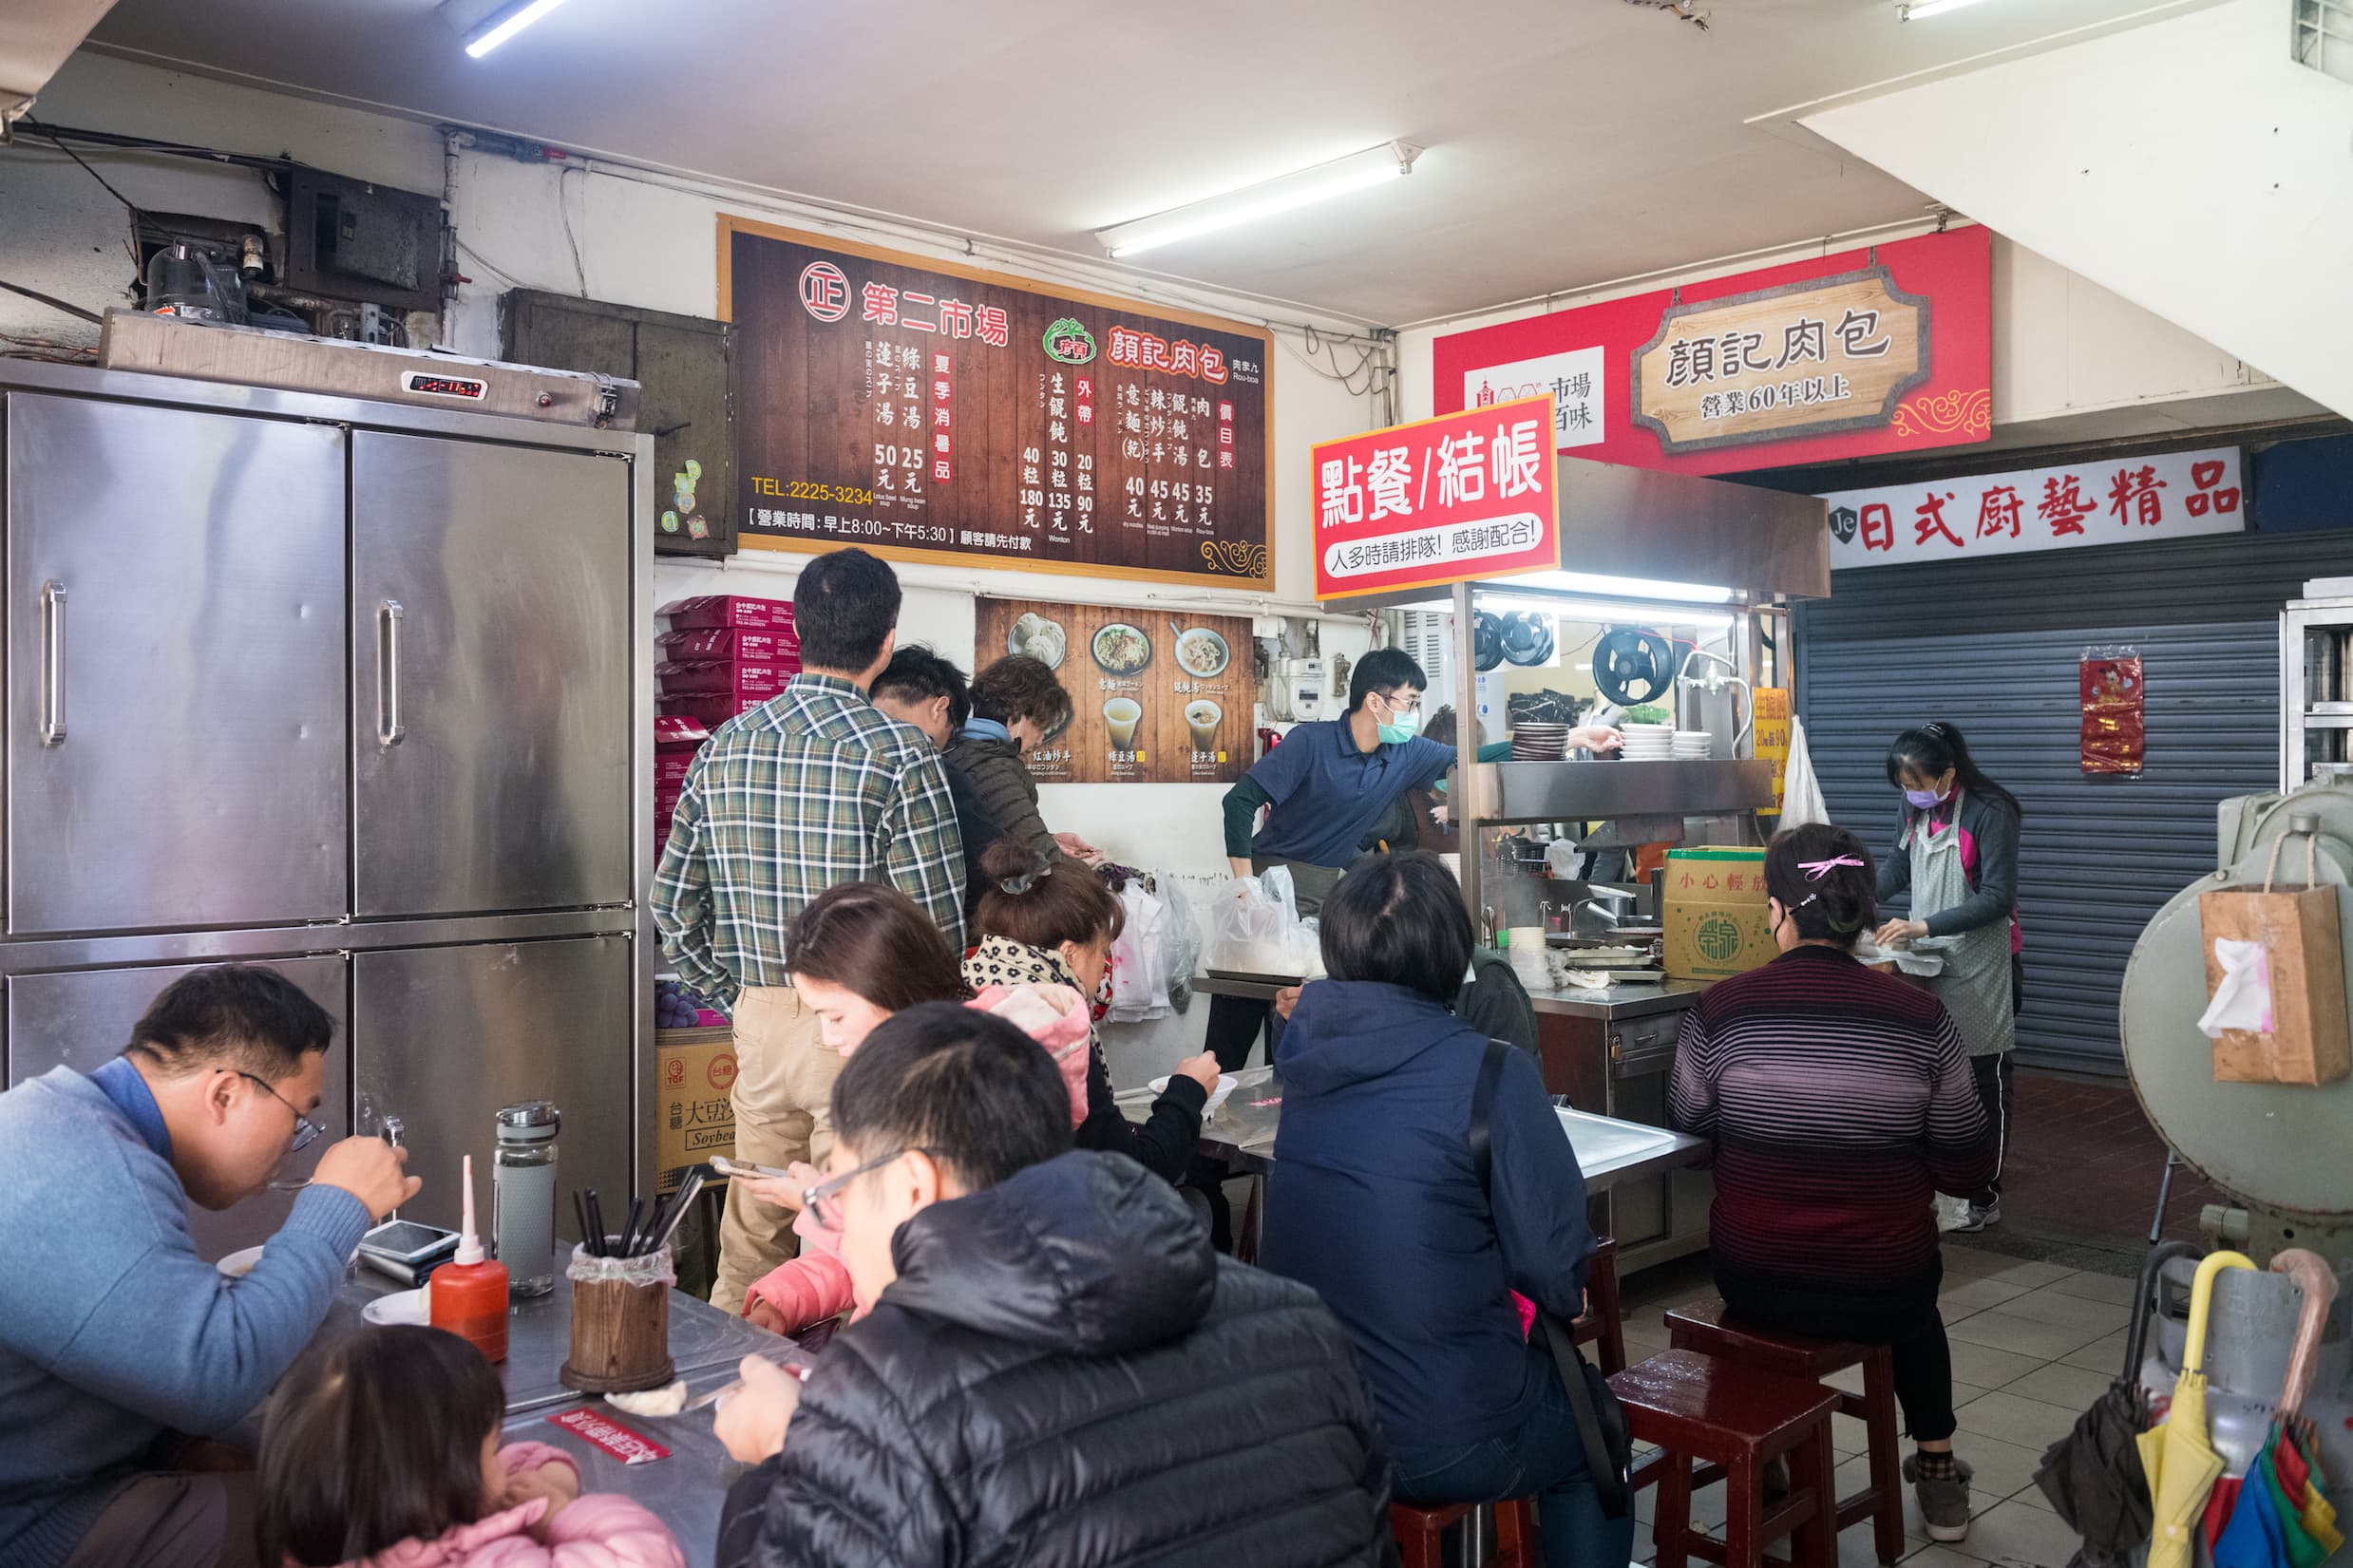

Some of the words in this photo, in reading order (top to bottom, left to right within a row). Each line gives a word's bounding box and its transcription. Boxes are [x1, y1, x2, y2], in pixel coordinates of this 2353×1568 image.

[862, 281, 1009, 348] 第二市場
[1109, 328, 1227, 383] 顏記肉包
[1665, 310, 1890, 387] 顏記肉包
[875, 340, 895, 426] 蓮子湯
[901, 346, 921, 430] 綠豆湯
[1049, 372, 1068, 444] 生餛飩
[1077, 380, 1092, 423] 外帶
[1549, 372, 1591, 403] 市場
[1701, 375, 1850, 418] 營業60年以上
[934, 354, 951, 480] 夏季消暑品
[1172, 393, 1188, 466] 餛飩湯
[1197, 397, 1211, 468] 肉包
[1220, 404, 1233, 468] 價目表
[751, 477, 873, 506] TEL:2225-3234
[1322, 420, 1542, 529] 點餐/結帳
[1860, 460, 2240, 552] 日式廚藝精品
[960, 530, 1032, 551] 顧客請先付款
[1331, 534, 1442, 572] 人多時請排隊!
[1452, 520, 1535, 555] 感謝配合!
[670, 1102, 684, 1130] 台糖
